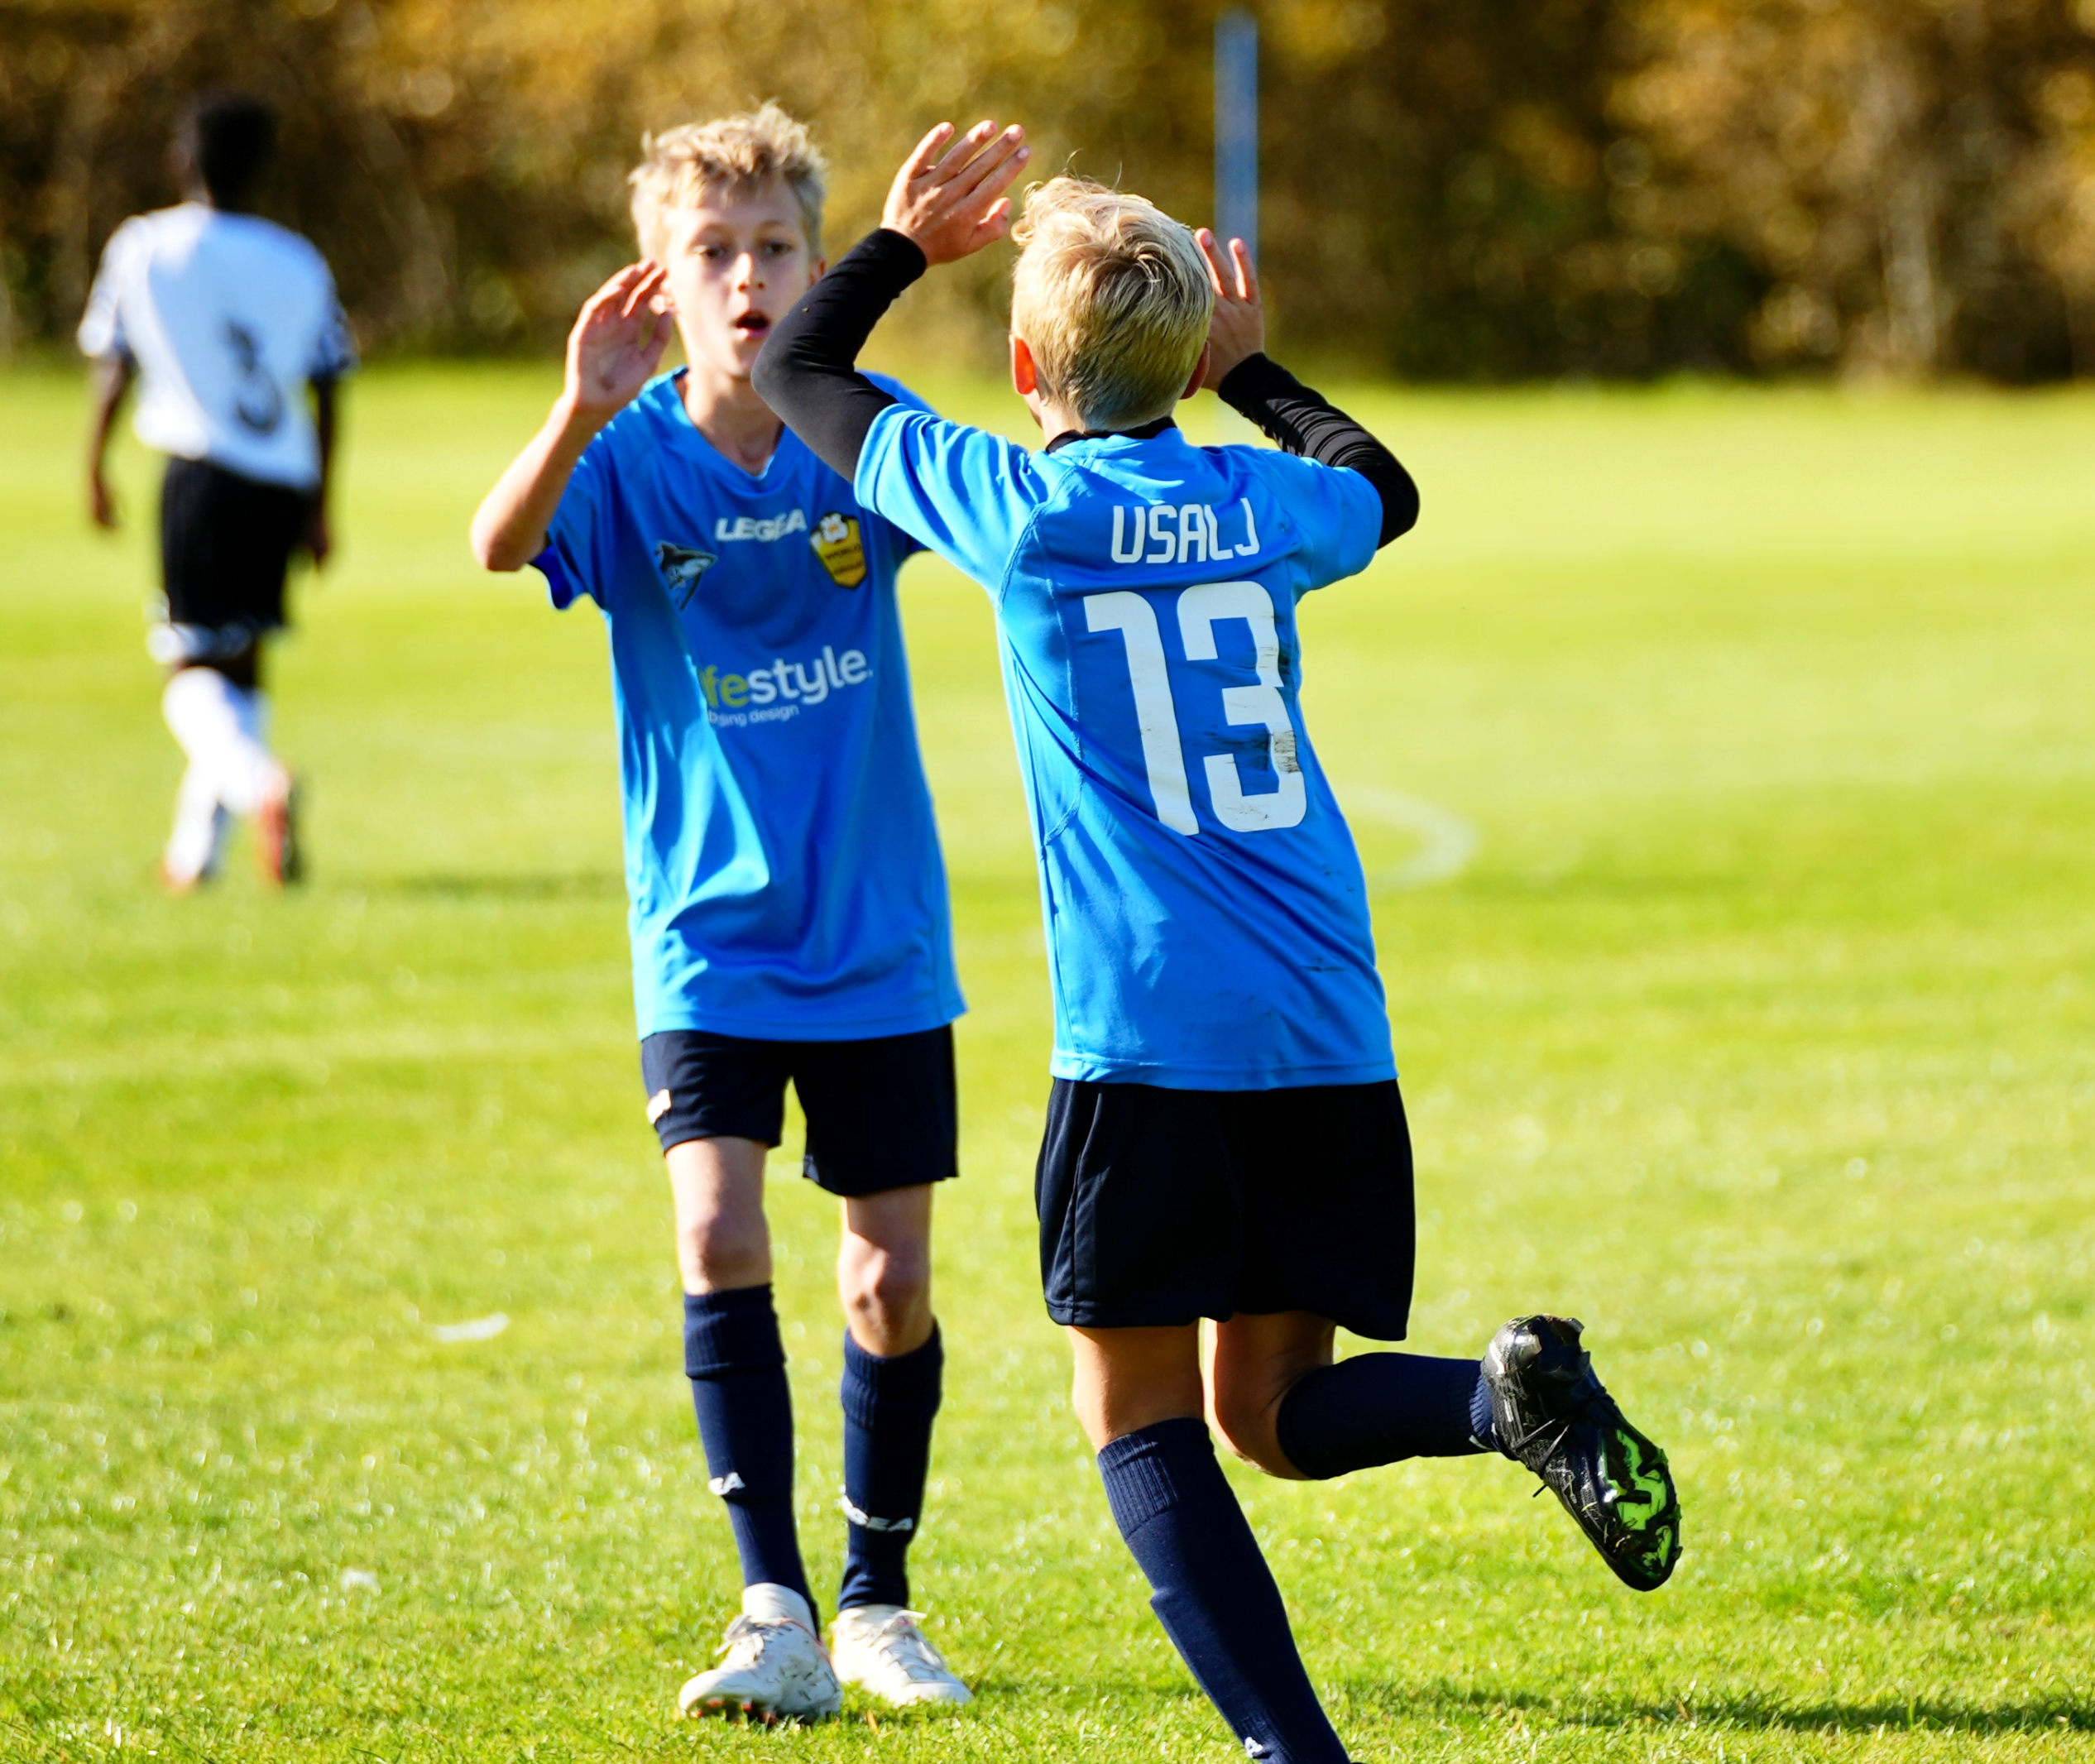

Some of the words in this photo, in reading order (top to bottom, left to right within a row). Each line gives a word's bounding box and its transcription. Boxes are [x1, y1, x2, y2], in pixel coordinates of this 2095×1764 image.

[224, 319, 281, 434] 3
[1111, 498, 1260, 563] USALJ
[748, 705, 799, 724] design
[1083, 581, 1306, 836] 13
